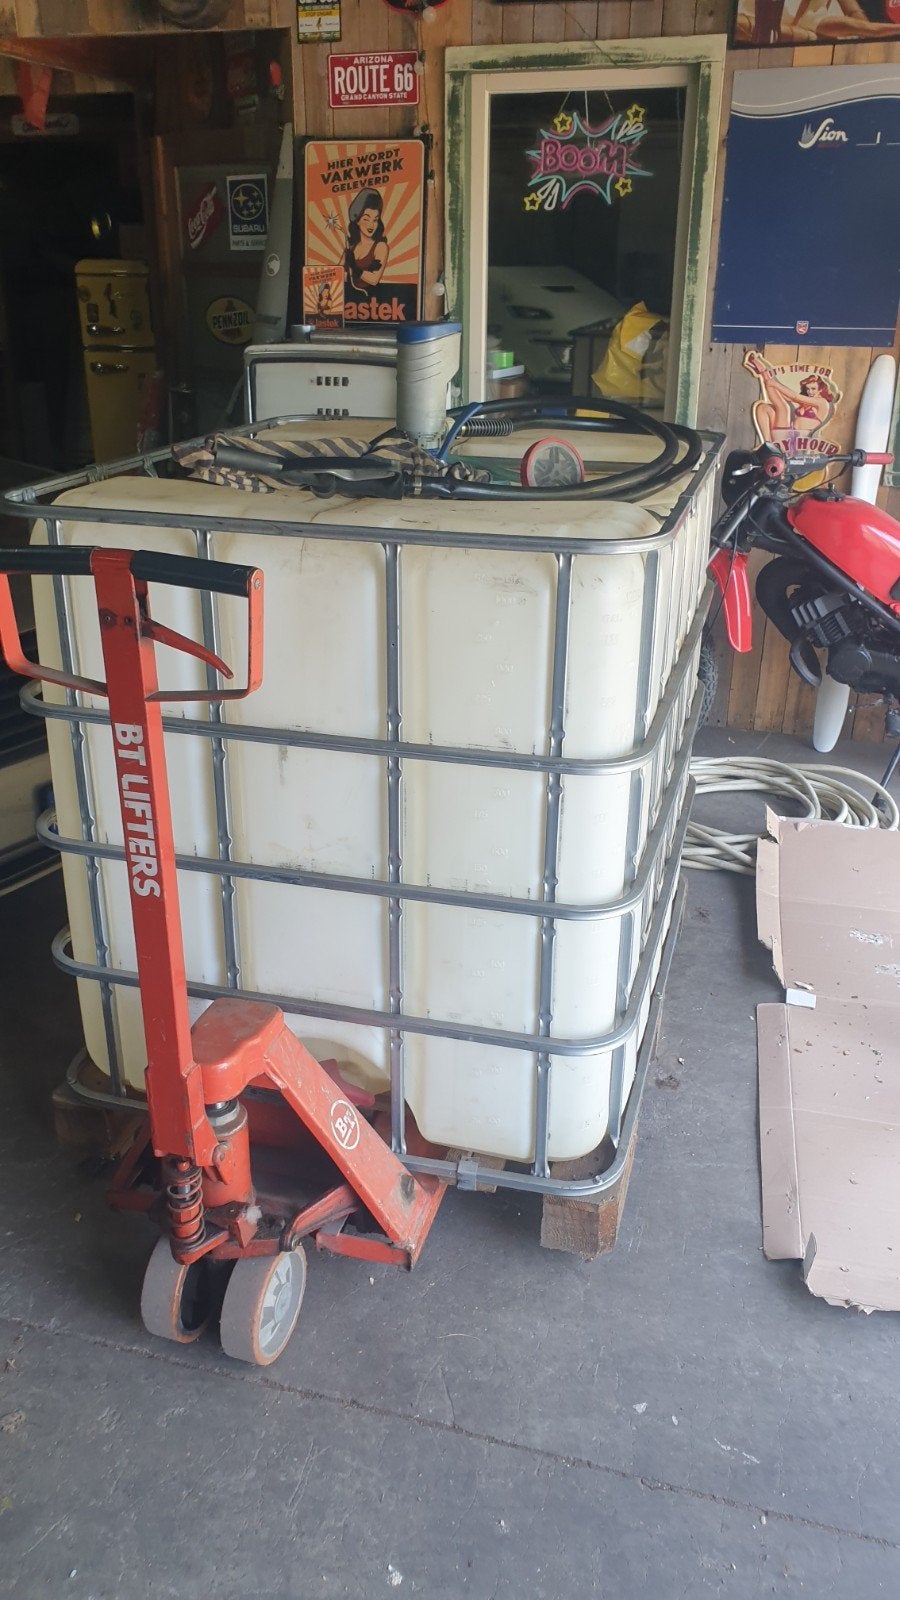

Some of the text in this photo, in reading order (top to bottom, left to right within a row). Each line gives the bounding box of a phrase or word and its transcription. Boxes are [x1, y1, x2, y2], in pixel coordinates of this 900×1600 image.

[353, 55, 394, 65] ARIZONA
[334, 63, 413, 95] ROUTE 66
[798, 117, 848, 149] Sion
[327, 148, 400, 171] HIER WORDT
[320, 157, 404, 185] VAKWERK
[331, 175, 390, 193] GELEVERD
[233, 224, 265, 233] SUBARU
[344, 296, 406, 321] astek
[211, 310, 250, 329] PENNZOIL
[768, 364, 832, 378] IT'S TIME FOR
[797, 437, 839, 456] HOUR
[114, 722, 161, 899] BT LIFTERS
